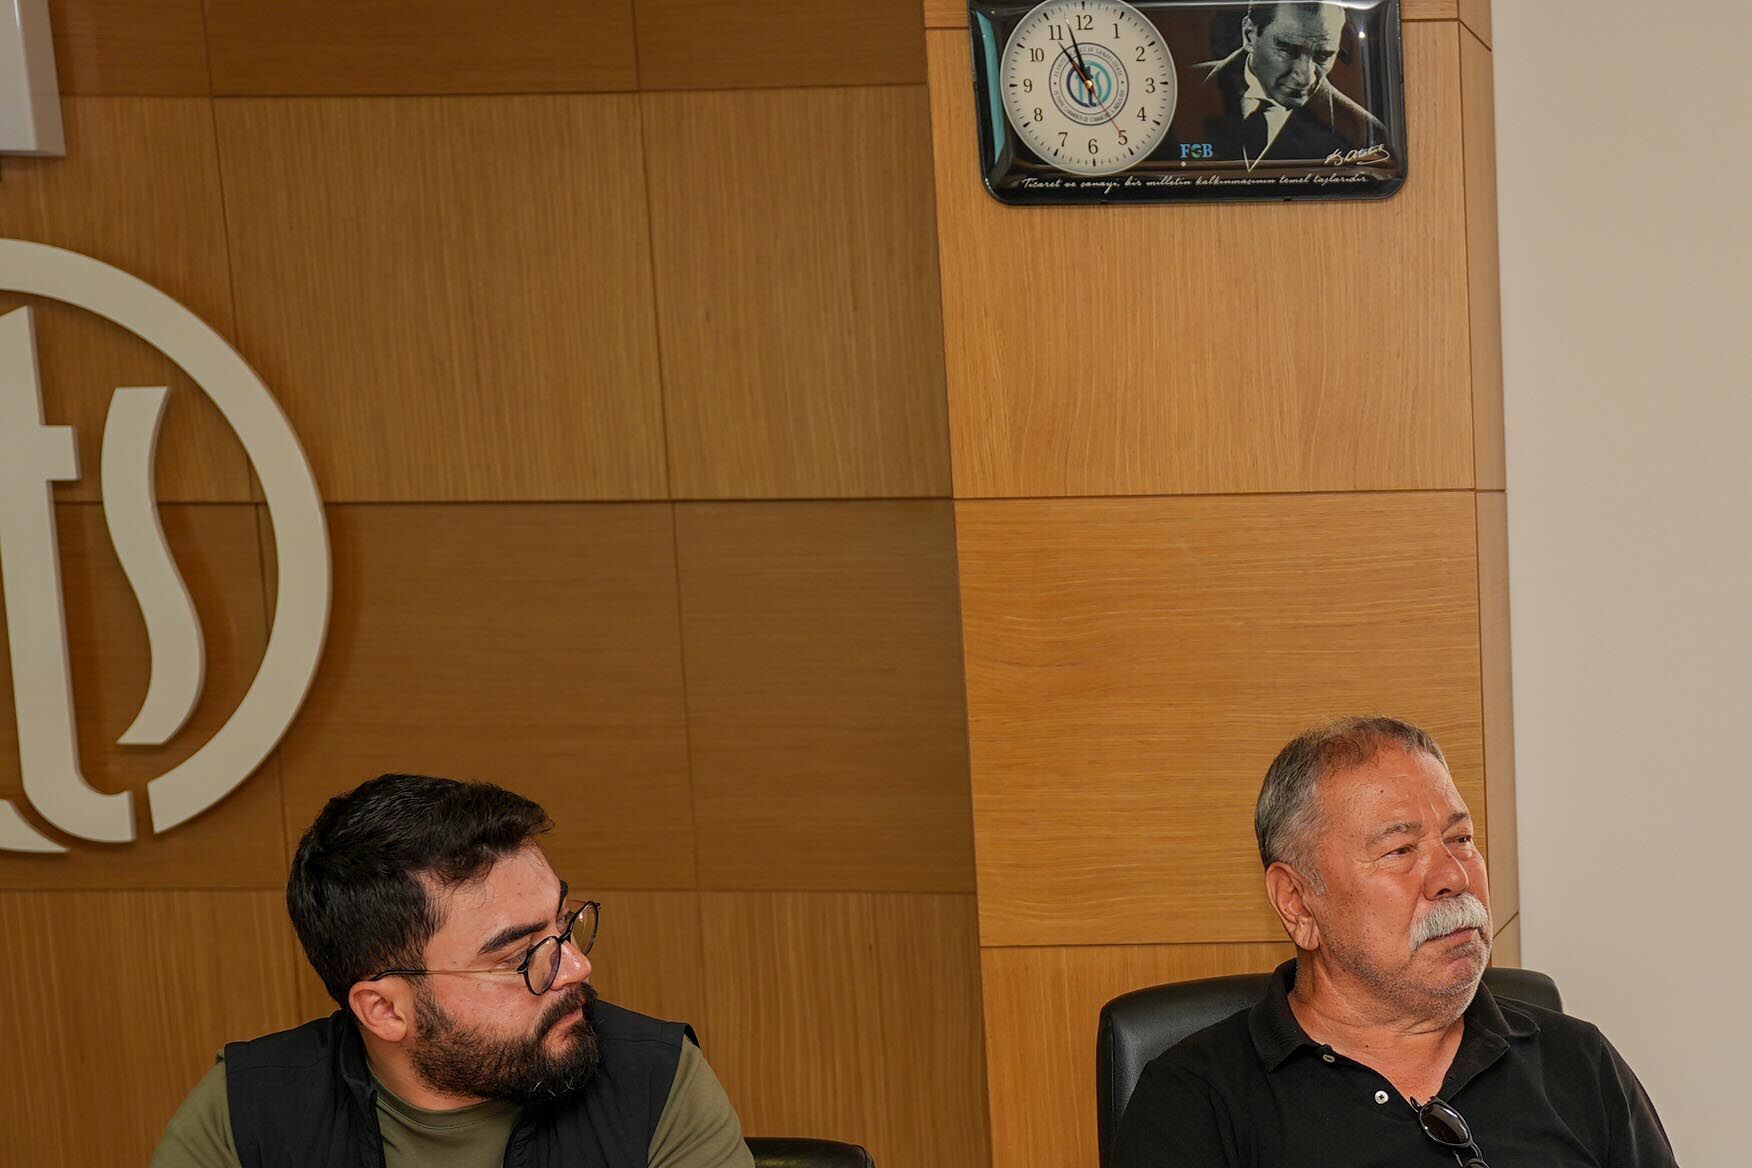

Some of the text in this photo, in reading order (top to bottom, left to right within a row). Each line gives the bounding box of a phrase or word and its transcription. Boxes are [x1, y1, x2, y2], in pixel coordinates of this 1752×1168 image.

[1075, 14, 1094, 31] 12
[1048, 24, 1064, 41] 11
[1112, 23, 1121, 39] 1
[1029, 47, 1045, 63] 10
[1135, 46, 1146, 62] 2
[1023, 79, 1033, 93] 9
[1145, 77, 1156, 94] 3
[1033, 108, 1044, 122] 8
[1136, 106, 1147, 122] 4
[1058, 131, 1069, 148] 7
[1117, 129, 1128, 146] 5
[1087, 138, 1099, 155] 6
[1021, 177, 1062, 188] Ticaret
[1124, 175, 1142, 187] bir
[1146, 175, 1193, 187] milletin
[1279, 173, 1311, 184] temel
